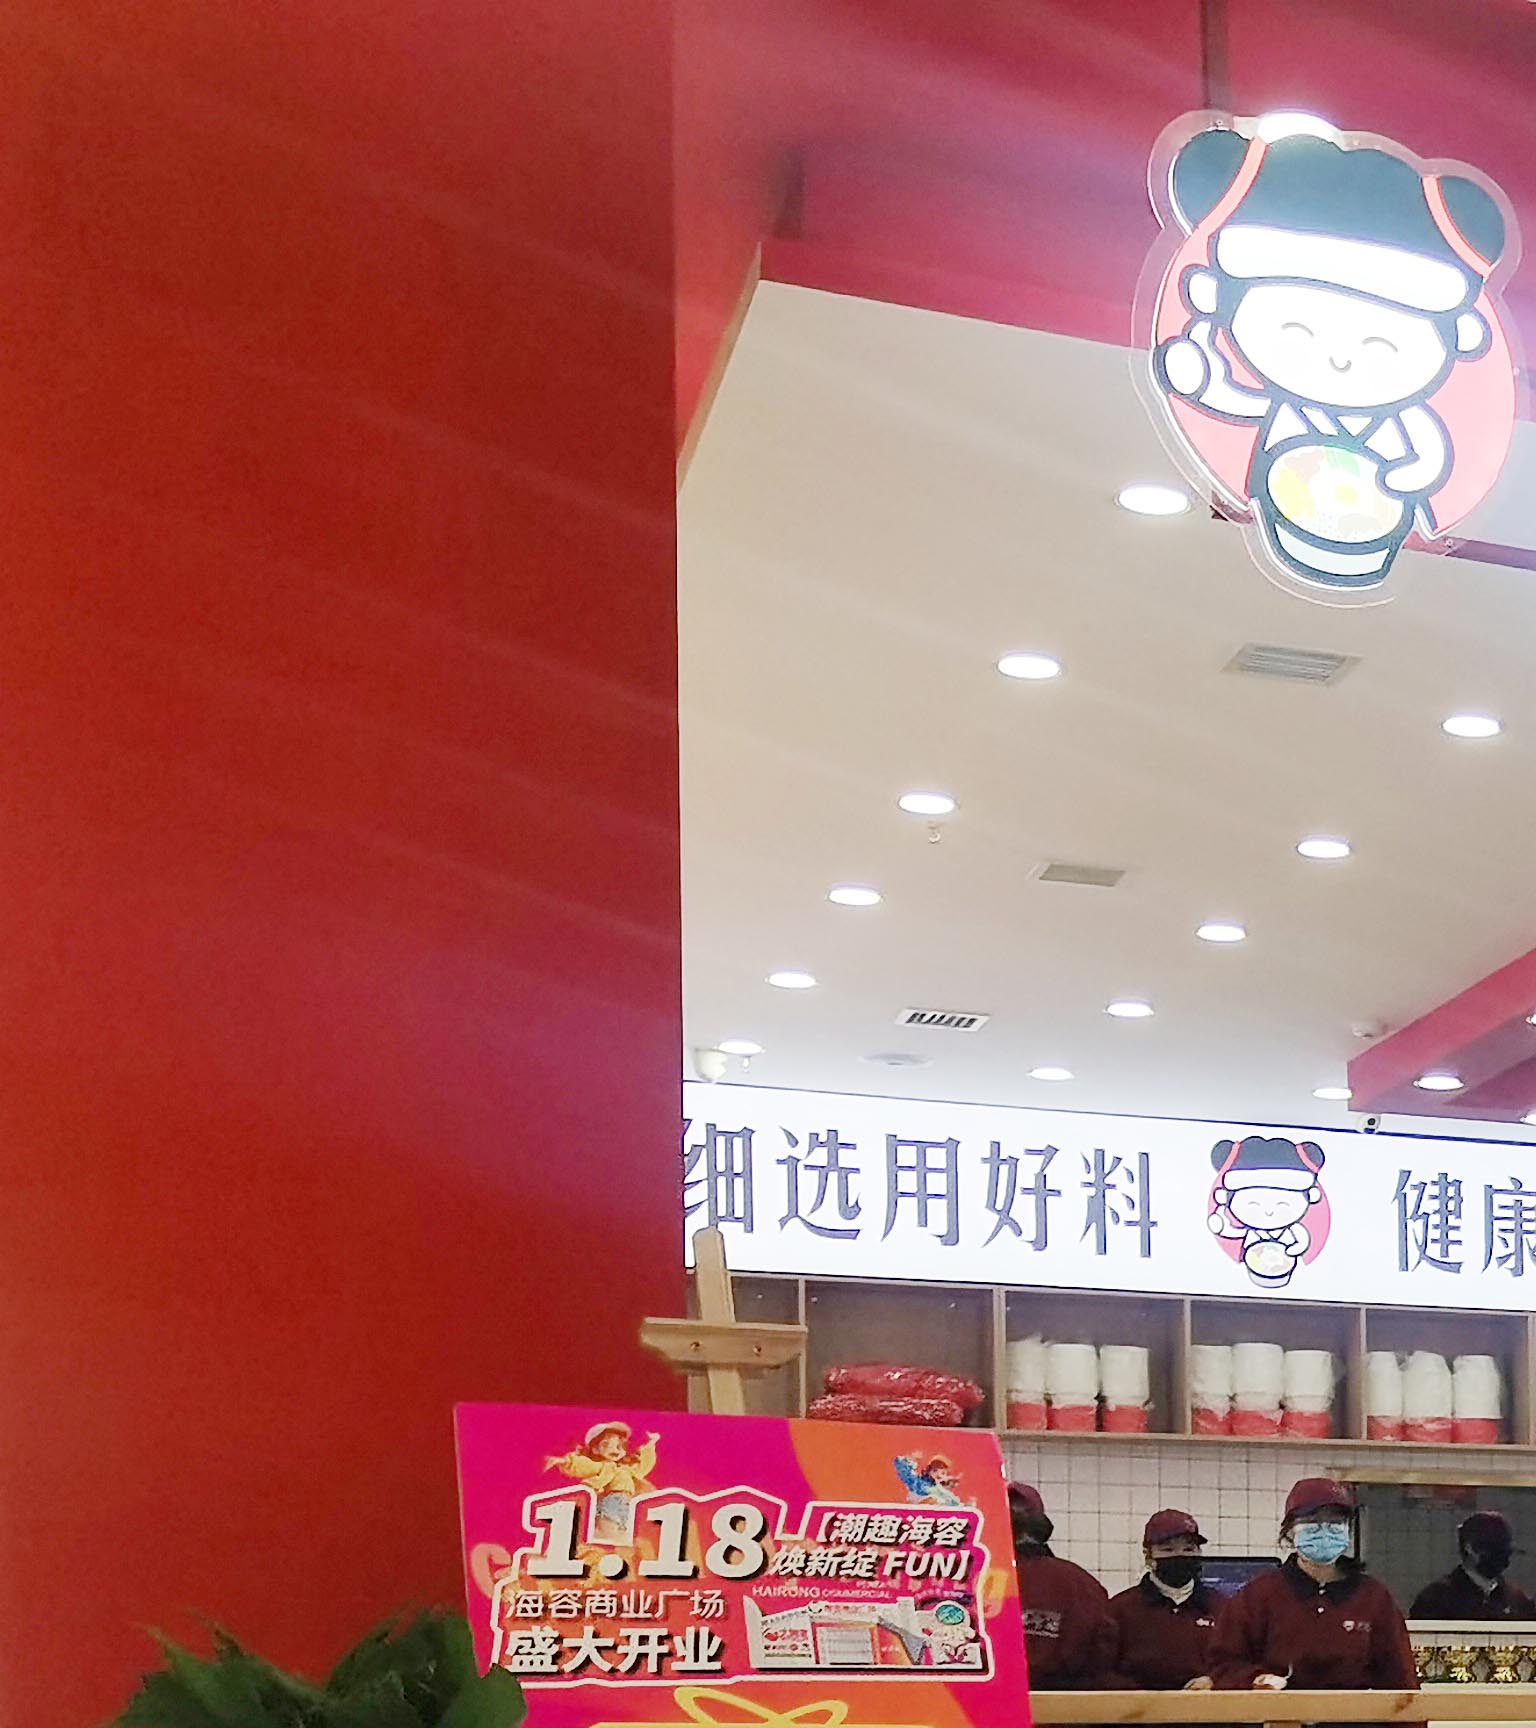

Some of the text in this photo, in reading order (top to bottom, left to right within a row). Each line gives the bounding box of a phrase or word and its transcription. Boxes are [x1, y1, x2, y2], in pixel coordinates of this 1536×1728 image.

[527, 1502, 768, 1582] 1.18
[506, 1587, 726, 1622] 海容商业广场
[504, 1626, 724, 1674] 盛大开业
